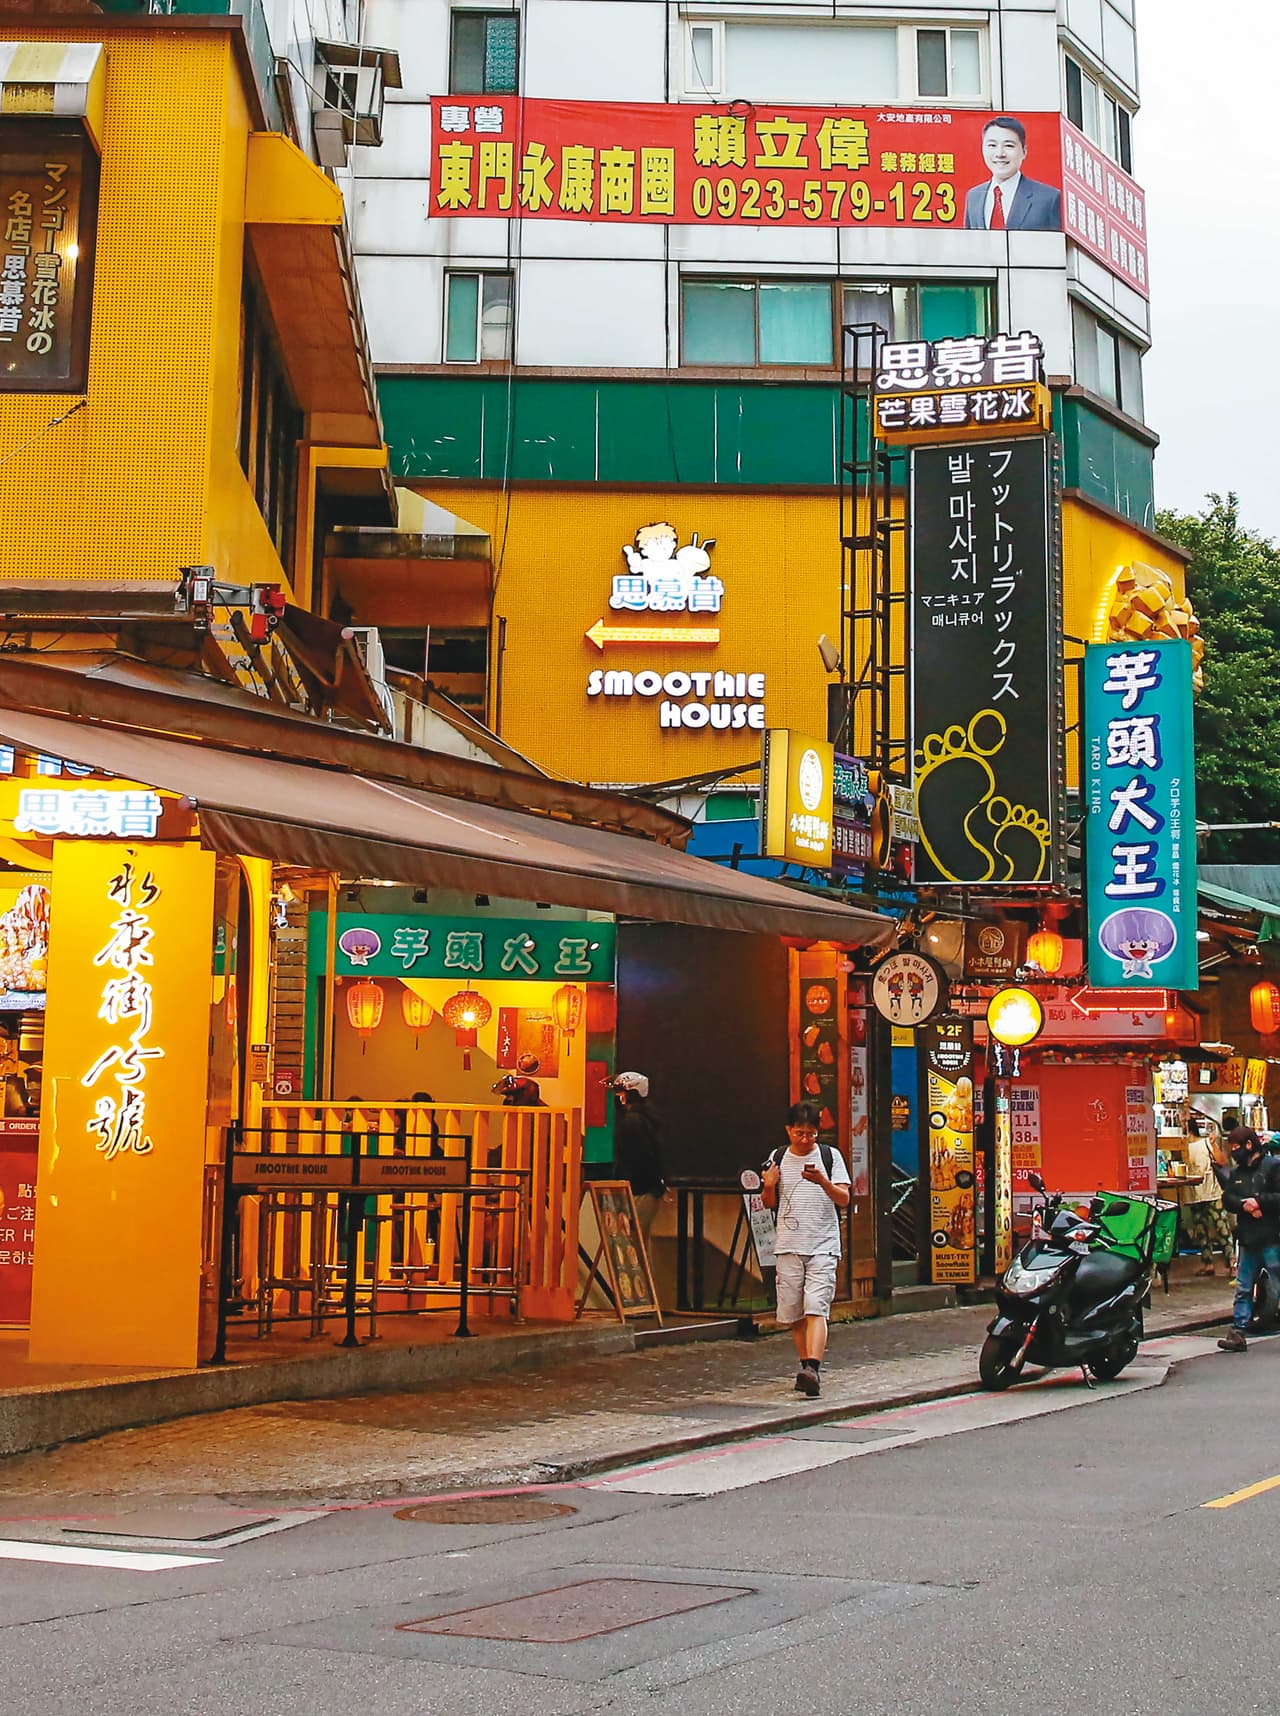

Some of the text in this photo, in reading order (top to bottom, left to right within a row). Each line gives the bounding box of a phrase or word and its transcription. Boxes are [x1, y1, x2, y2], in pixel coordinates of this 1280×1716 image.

[439, 107, 503, 134] 專營
[693, 114, 871, 170] 賴立偉
[437, 140, 677, 217] 東門永康商圈
[880, 150, 957, 175] 業務經理
[692, 177, 958, 222] 0923-579-123
[876, 332, 1042, 390] 思慕昔
[877, 389, 1033, 428] 芒果雪花冰
[611, 576, 723, 612] 思慕昔
[987, 450, 1020, 701] フットリラックス
[920, 592, 985, 608] マニキュア
[931, 611, 984, 627] 매니큐어
[587, 670, 765, 698] SMOOTHIE
[659, 701, 765, 729] HOUSE
[1090, 736, 1101, 815] TARO KING
[1102, 650, 1161, 900] 芋頭大王
[16, 789, 162, 837] 思慕昔
[391, 927, 593, 976] 芋頭大王
[946, 1025, 963, 1037] 2F
[8, 1122, 37, 1130] ORDER
